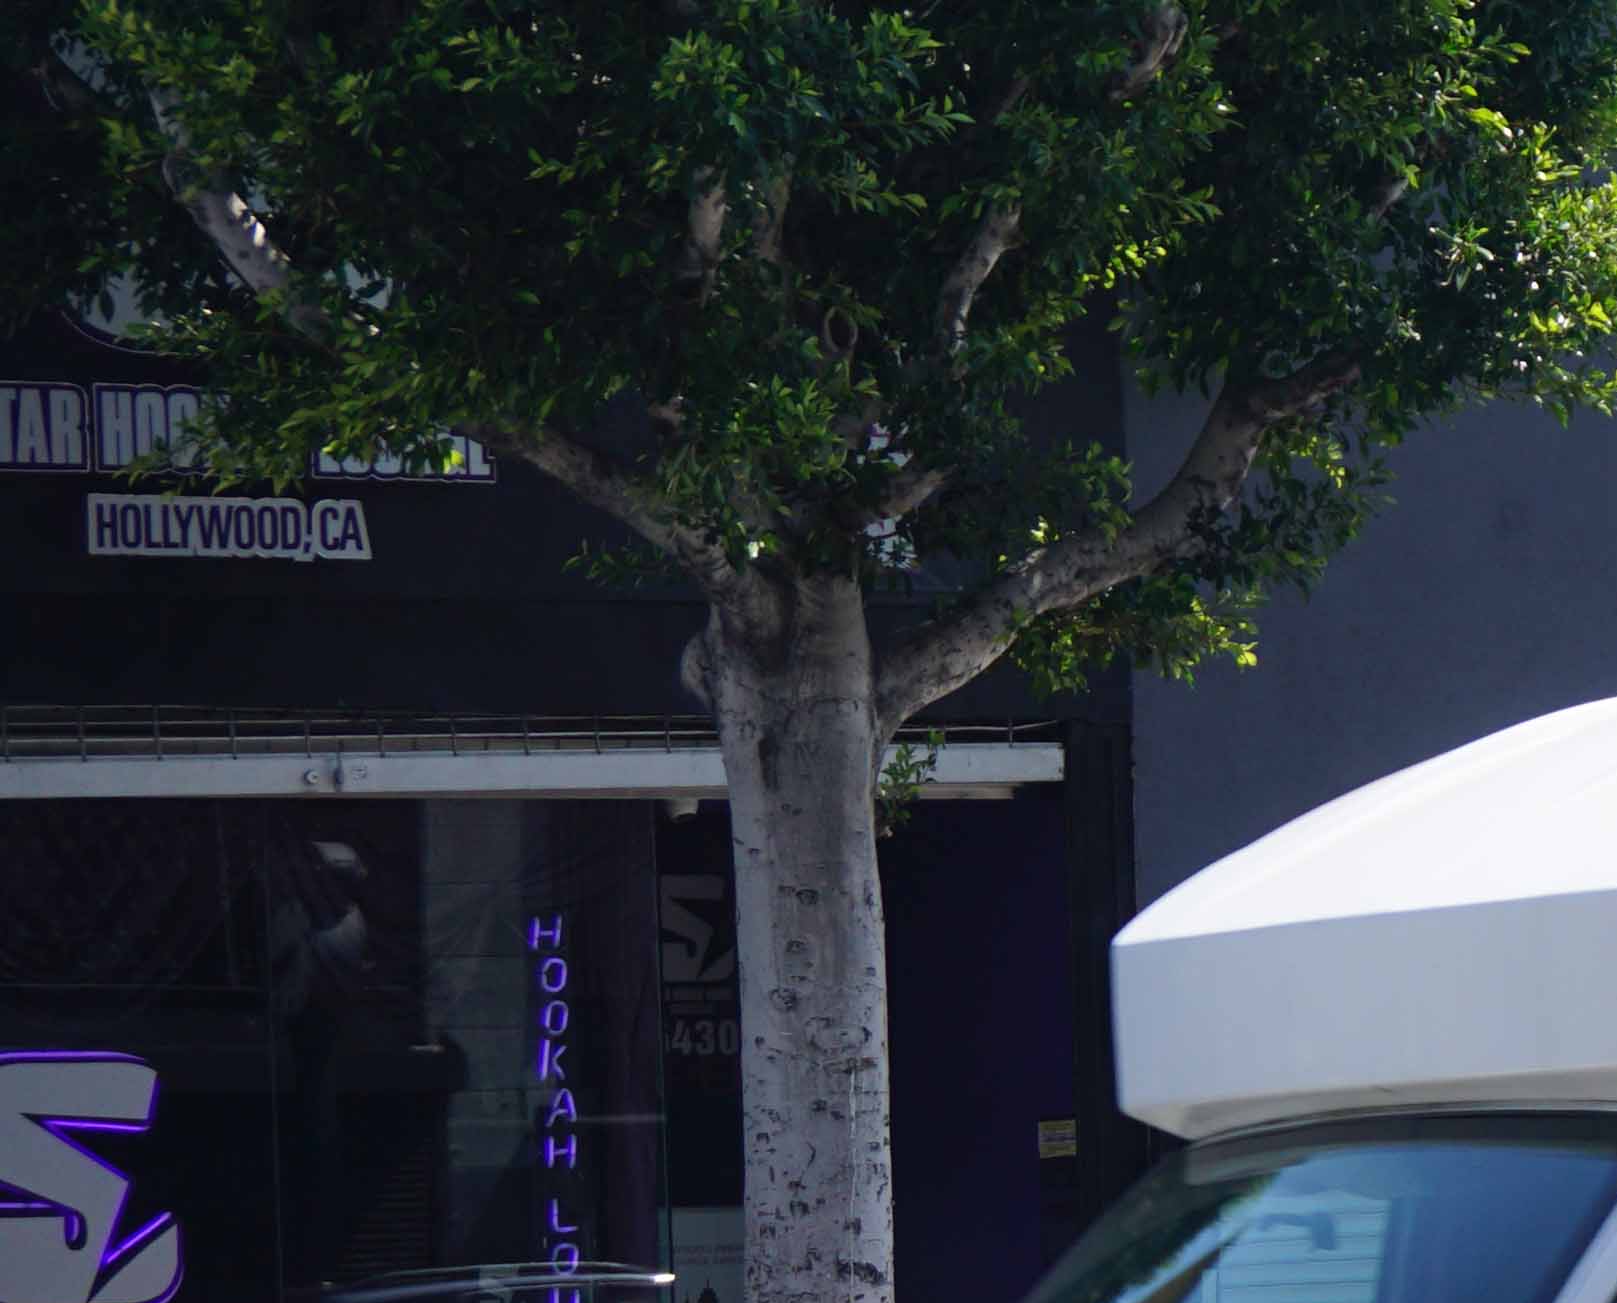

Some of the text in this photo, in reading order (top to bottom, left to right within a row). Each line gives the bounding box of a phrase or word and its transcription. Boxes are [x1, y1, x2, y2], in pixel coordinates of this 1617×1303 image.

[95, 502, 363, 554] HOLLYWOOD, CA
[530, 913, 578, 1169] HOOKAH
